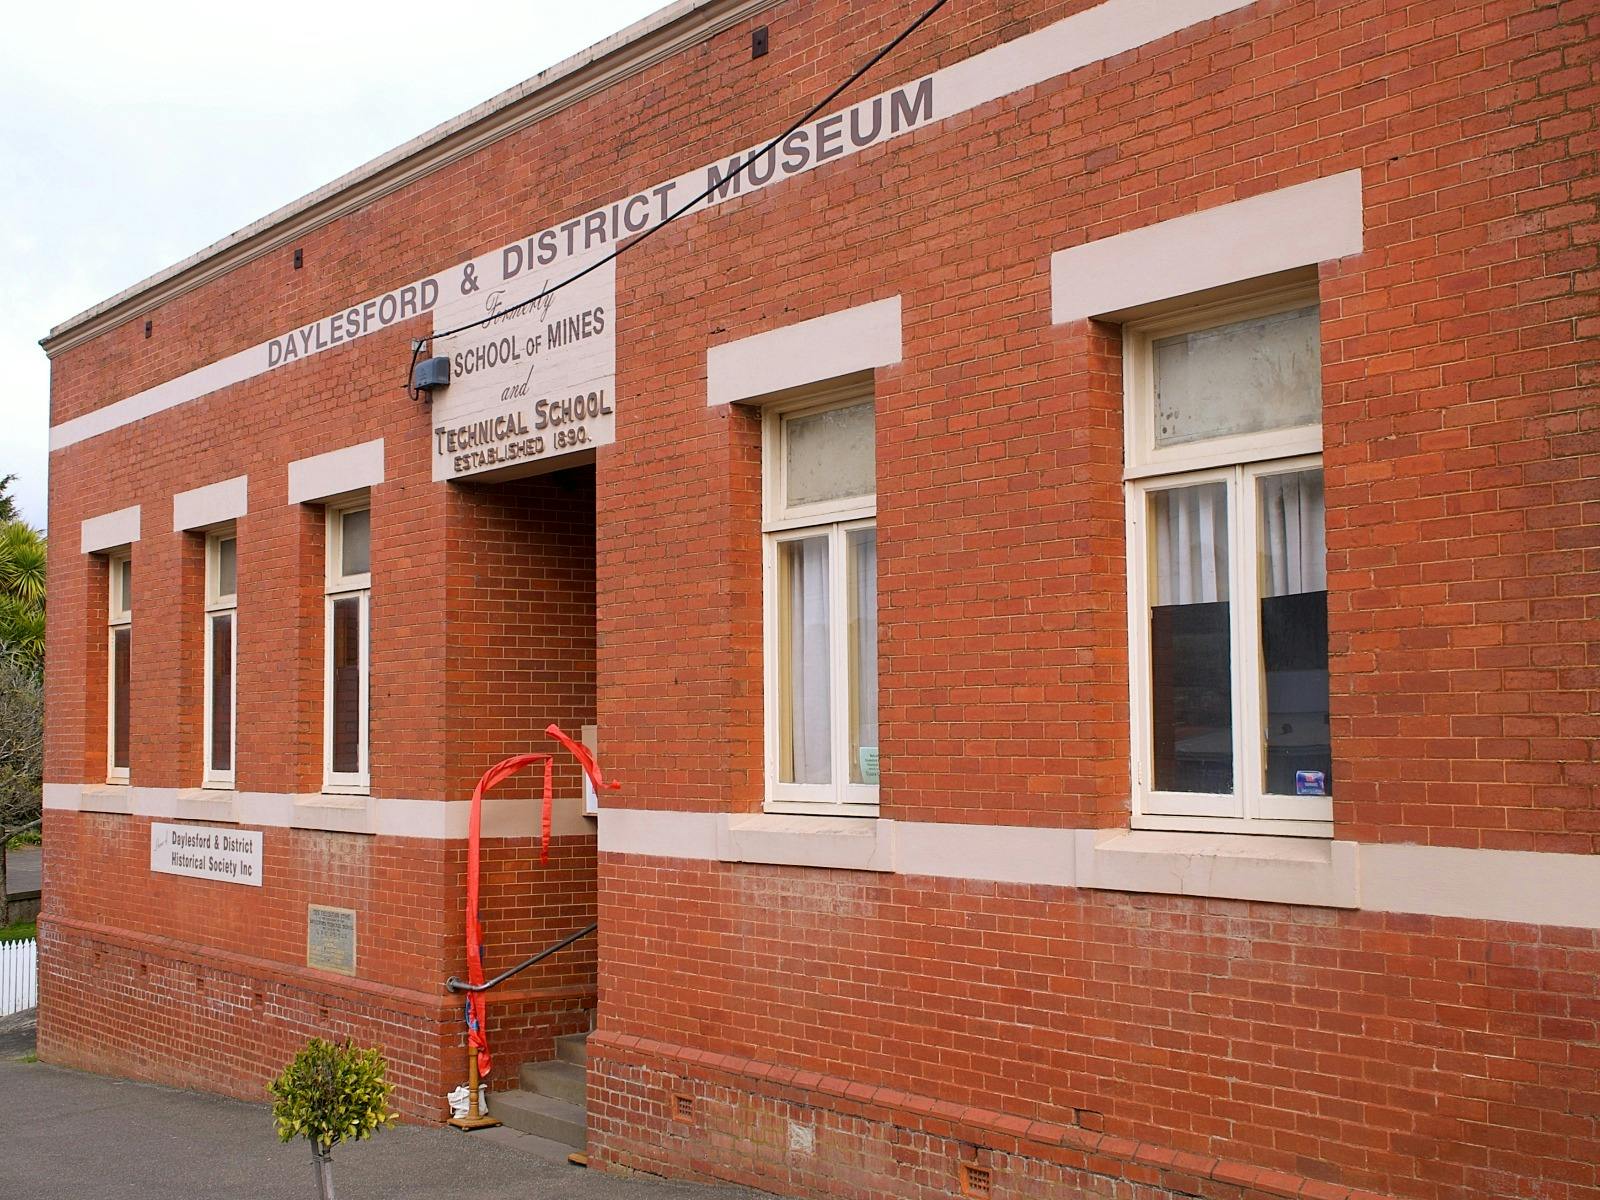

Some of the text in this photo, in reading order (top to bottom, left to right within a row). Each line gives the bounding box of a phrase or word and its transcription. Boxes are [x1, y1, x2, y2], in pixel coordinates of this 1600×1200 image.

[268, 77, 933, 367] DAYLESFORD & DISTRICT MUSEUM
[454, 335, 521, 378] SCHOOL
[547, 307, 605, 350] MINES
[501, 364, 535, 402] and
[434, 390, 613, 456] TECHNICAL SCHOOL
[454, 436, 546, 473] ESTABLISHED
[171, 830, 211, 850] Daylesford
[214, 834, 220, 850] &
[223, 835, 253, 854] District
[171, 851, 252, 877] Historical Society Inc
